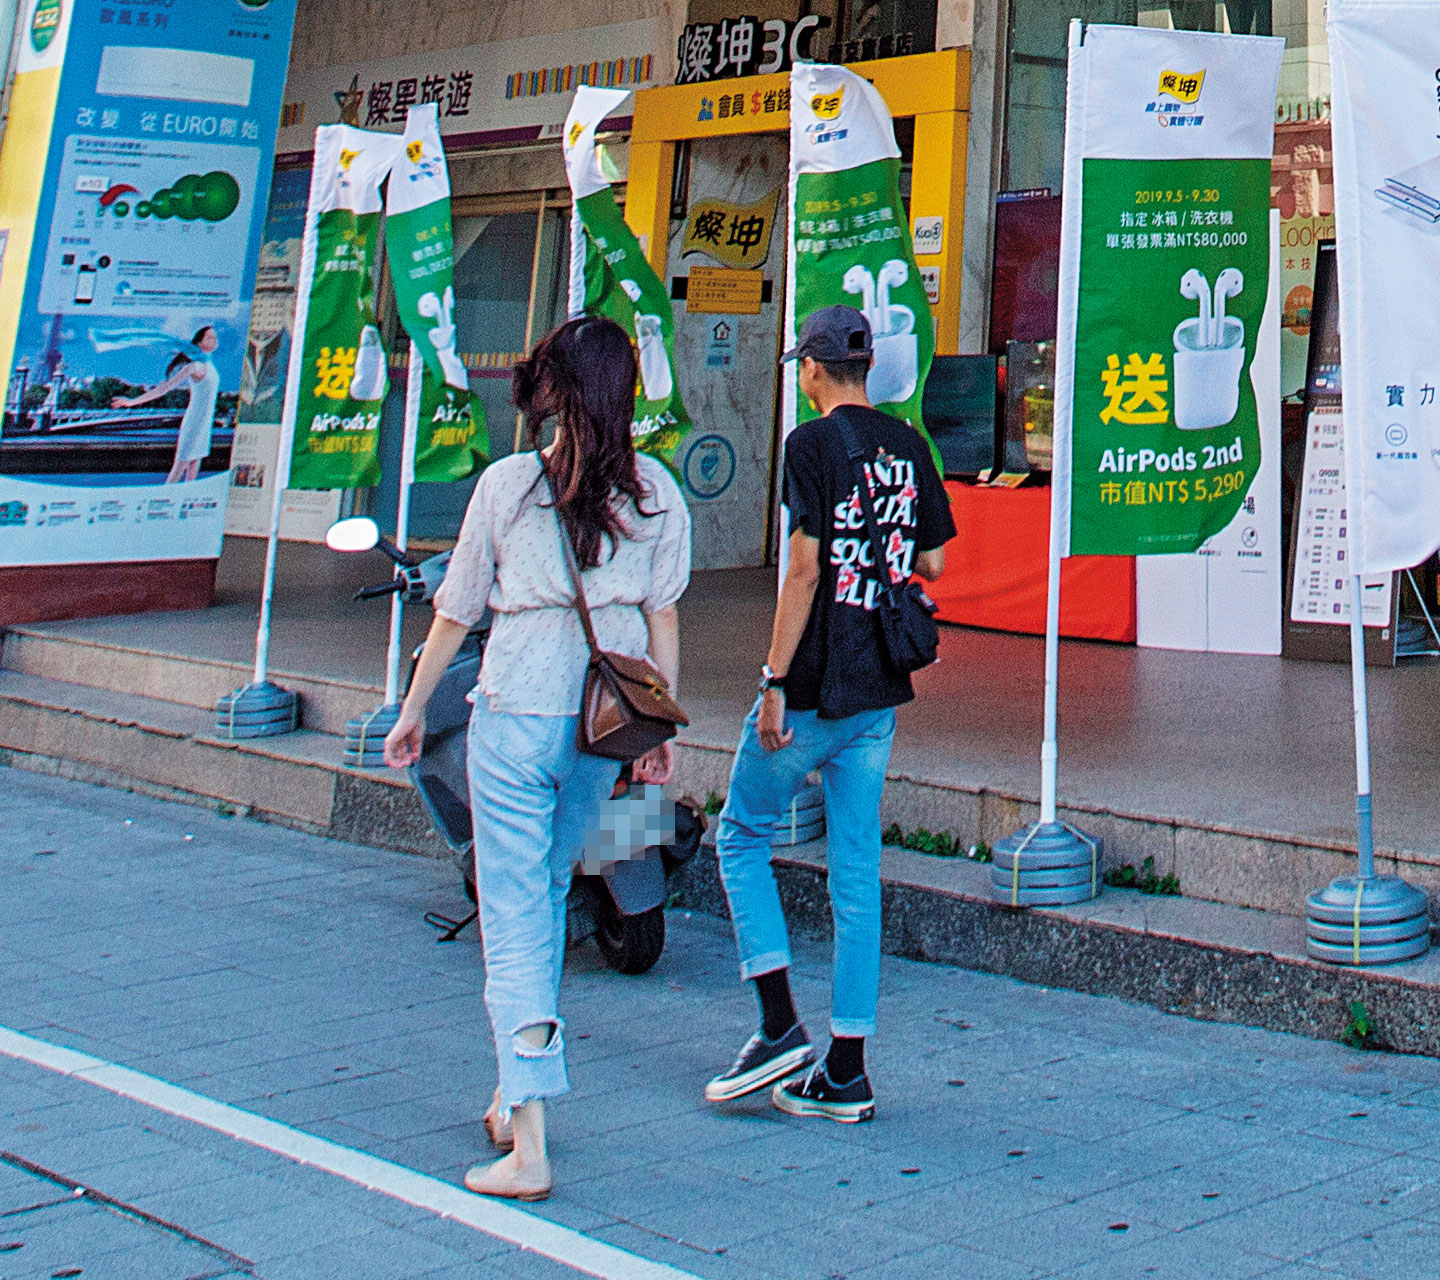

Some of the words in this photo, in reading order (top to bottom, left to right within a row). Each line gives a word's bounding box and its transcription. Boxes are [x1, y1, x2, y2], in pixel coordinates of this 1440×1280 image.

[365, 70, 474, 127] 燦星旅遊
[1162, 74, 1199, 97] 燦坤
[719, 93, 744, 118] 會員
[691, 209, 765, 257] 燦坤
[1120, 211, 1148, 227] 指定
[1151, 211, 1178, 227] 冰箱
[1190, 210, 1234, 226] 洗衣機
[1106, 231, 1248, 249] 單張發票滿NT$80,000
[313, 347, 357, 400] 送
[1098, 352, 1170, 426] 送
[1098, 446, 1197, 474] AirPods
[1201, 436, 1244, 470] 2nd
[1099, 478, 1189, 506] 市值NT$
[1194, 470, 1245, 503] 5,290
